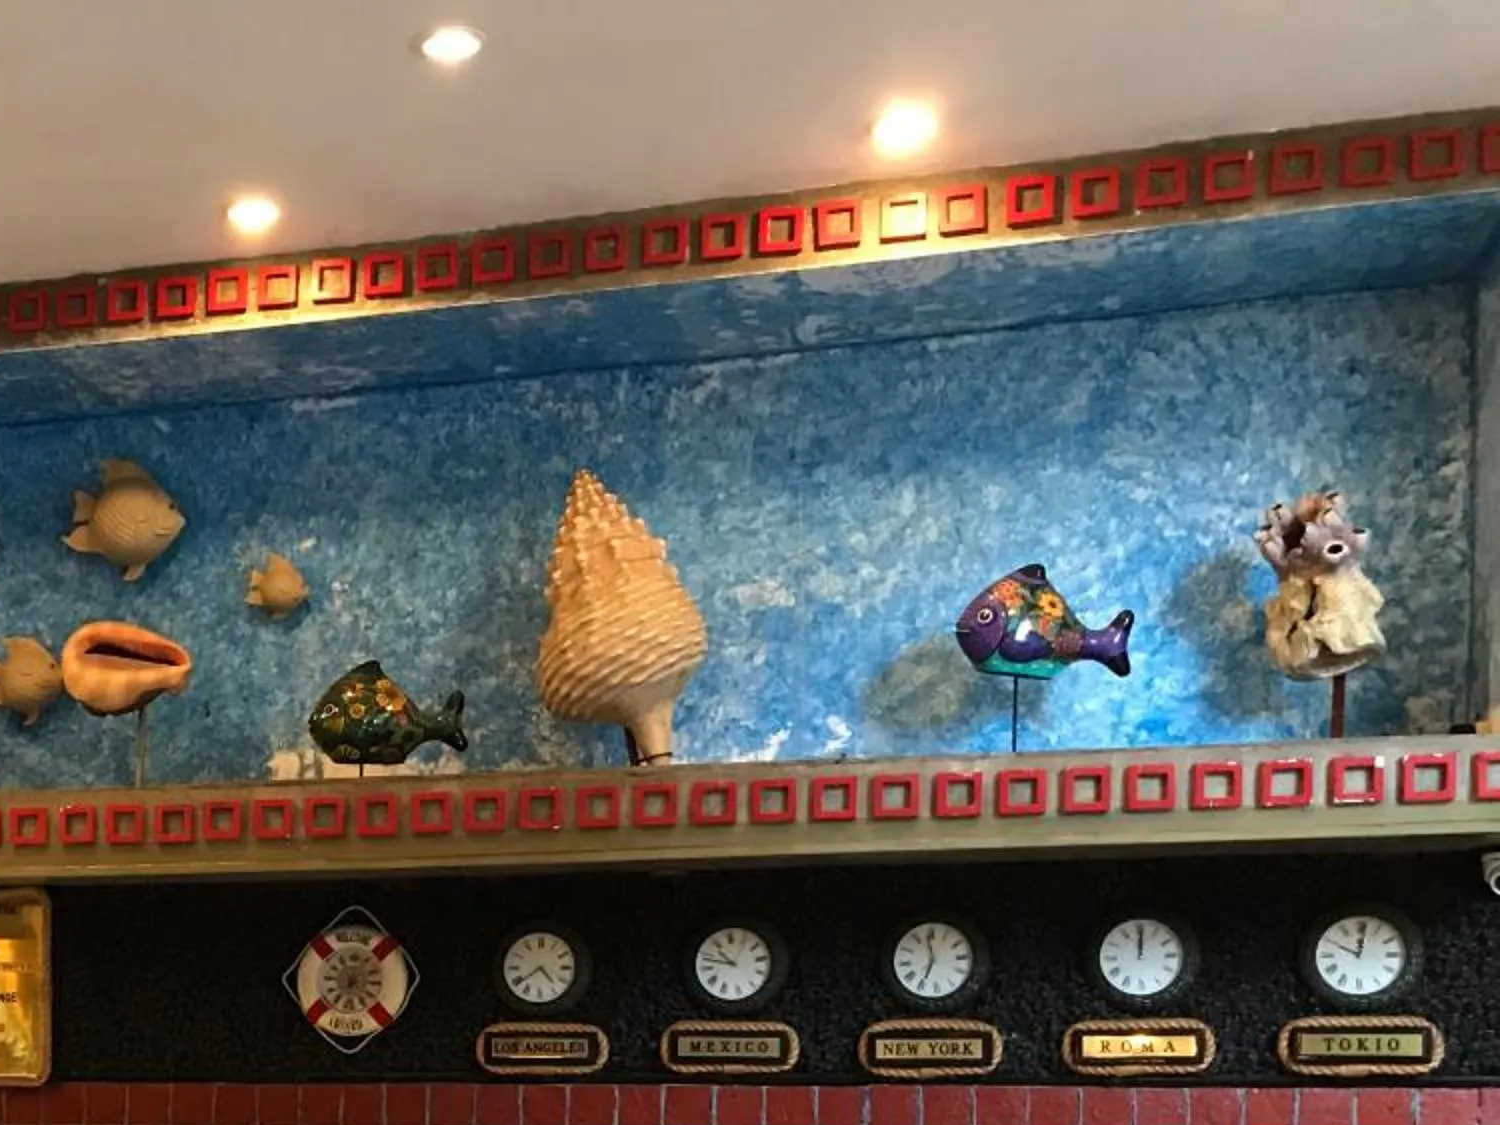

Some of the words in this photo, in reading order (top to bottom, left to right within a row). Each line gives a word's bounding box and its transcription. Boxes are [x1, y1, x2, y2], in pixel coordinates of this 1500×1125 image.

[493, 1041, 519, 1055] LOS
[522, 1040, 586, 1054] ANGELES
[689, 1041, 770, 1053] MEXICO
[882, 1042, 920, 1057] NEW
[928, 1041, 973, 1056] YORK
[1100, 1039, 1176, 1054] ROMA
[1323, 1037, 1401, 1052] TOKIO
